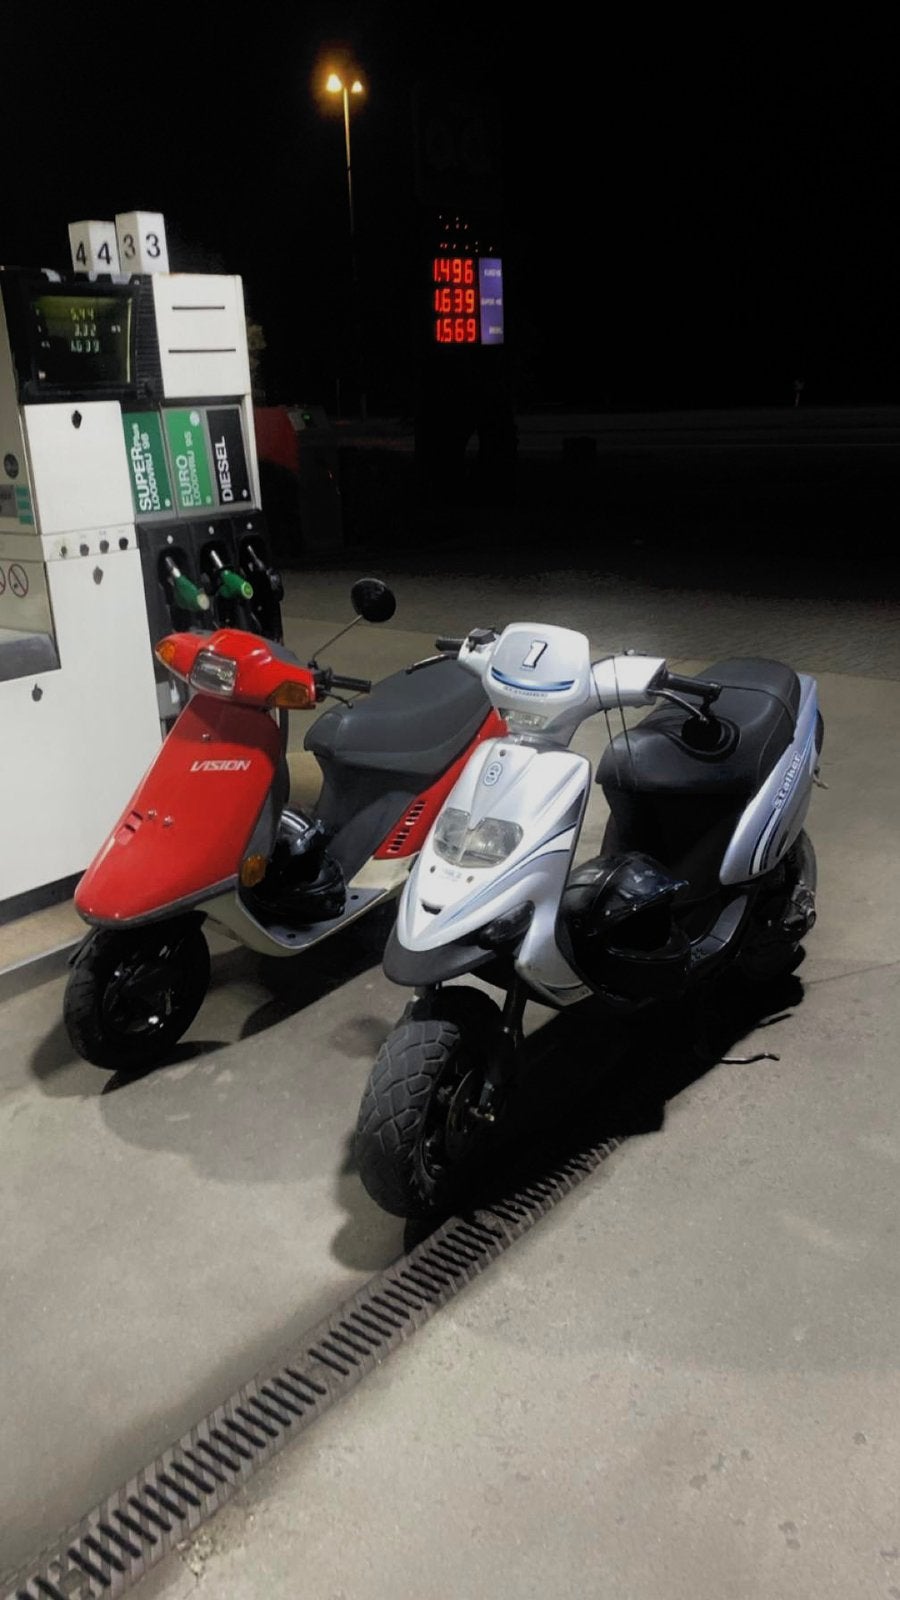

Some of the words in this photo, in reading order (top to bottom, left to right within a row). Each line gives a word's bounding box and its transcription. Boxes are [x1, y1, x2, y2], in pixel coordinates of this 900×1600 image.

[76, 241, 86, 266] 4
[97, 241, 112, 265] 4
[123, 233, 136, 258] 3
[145, 233, 161, 258] 3
[434, 258, 473, 284] 1.496
[435, 288, 475, 313] 1.639
[436, 318, 476, 342] 1.569
[131, 447, 152, 511] SUPER
[176, 455, 194, 507] EURO
[215, 435, 234, 502] DIESEL
[522, 640, 548, 669] 1
[190, 760, 251, 772] VISION
[774, 750, 801, 810] Stalker
